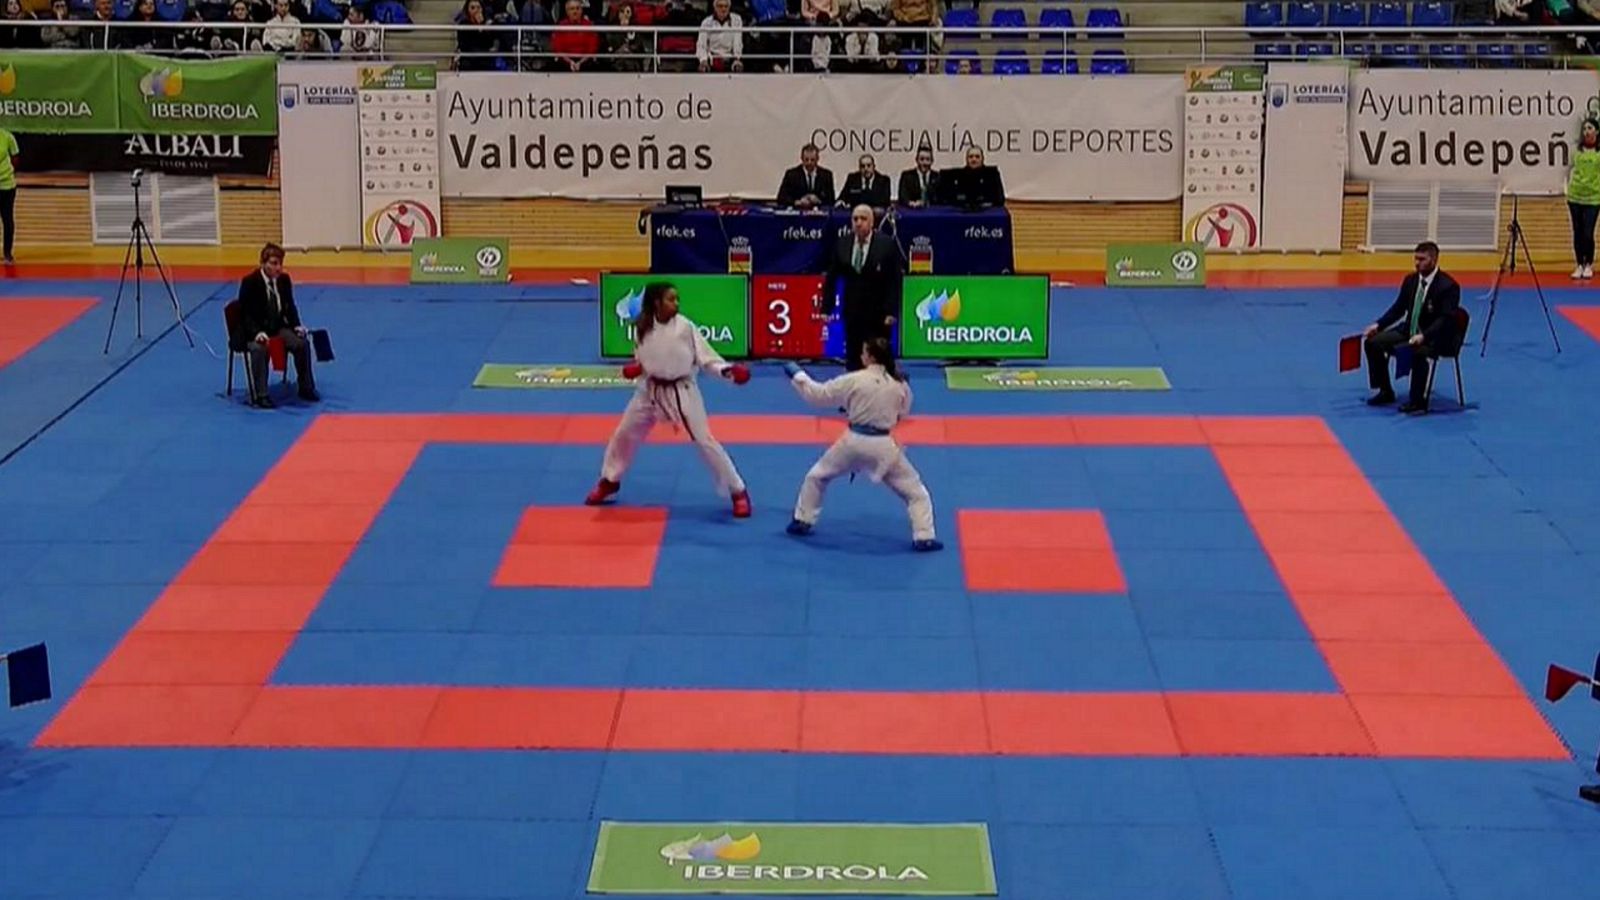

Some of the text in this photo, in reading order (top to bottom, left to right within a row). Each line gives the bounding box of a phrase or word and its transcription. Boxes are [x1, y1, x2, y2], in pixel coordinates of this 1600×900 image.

[152, 102, 259, 119] IBERDROLA
[448, 90, 713, 125] Ayuntamiento de
[1358, 87, 1574, 121] Ayuntamiento
[810, 123, 1174, 153] CONCEJALÍA DE DEPORTES
[449, 134, 713, 177] Valdepeñas
[1359, 130, 1570, 174] Valdepeñ
[656, 226, 696, 238] rfek.es
[783, 226, 823, 240] rfek.es
[964, 226, 1003, 238] rfek.es
[768, 299, 791, 335] 3
[927, 326, 1033, 342] IBERDROLA
[682, 864, 930, 881] IBERDROLA
